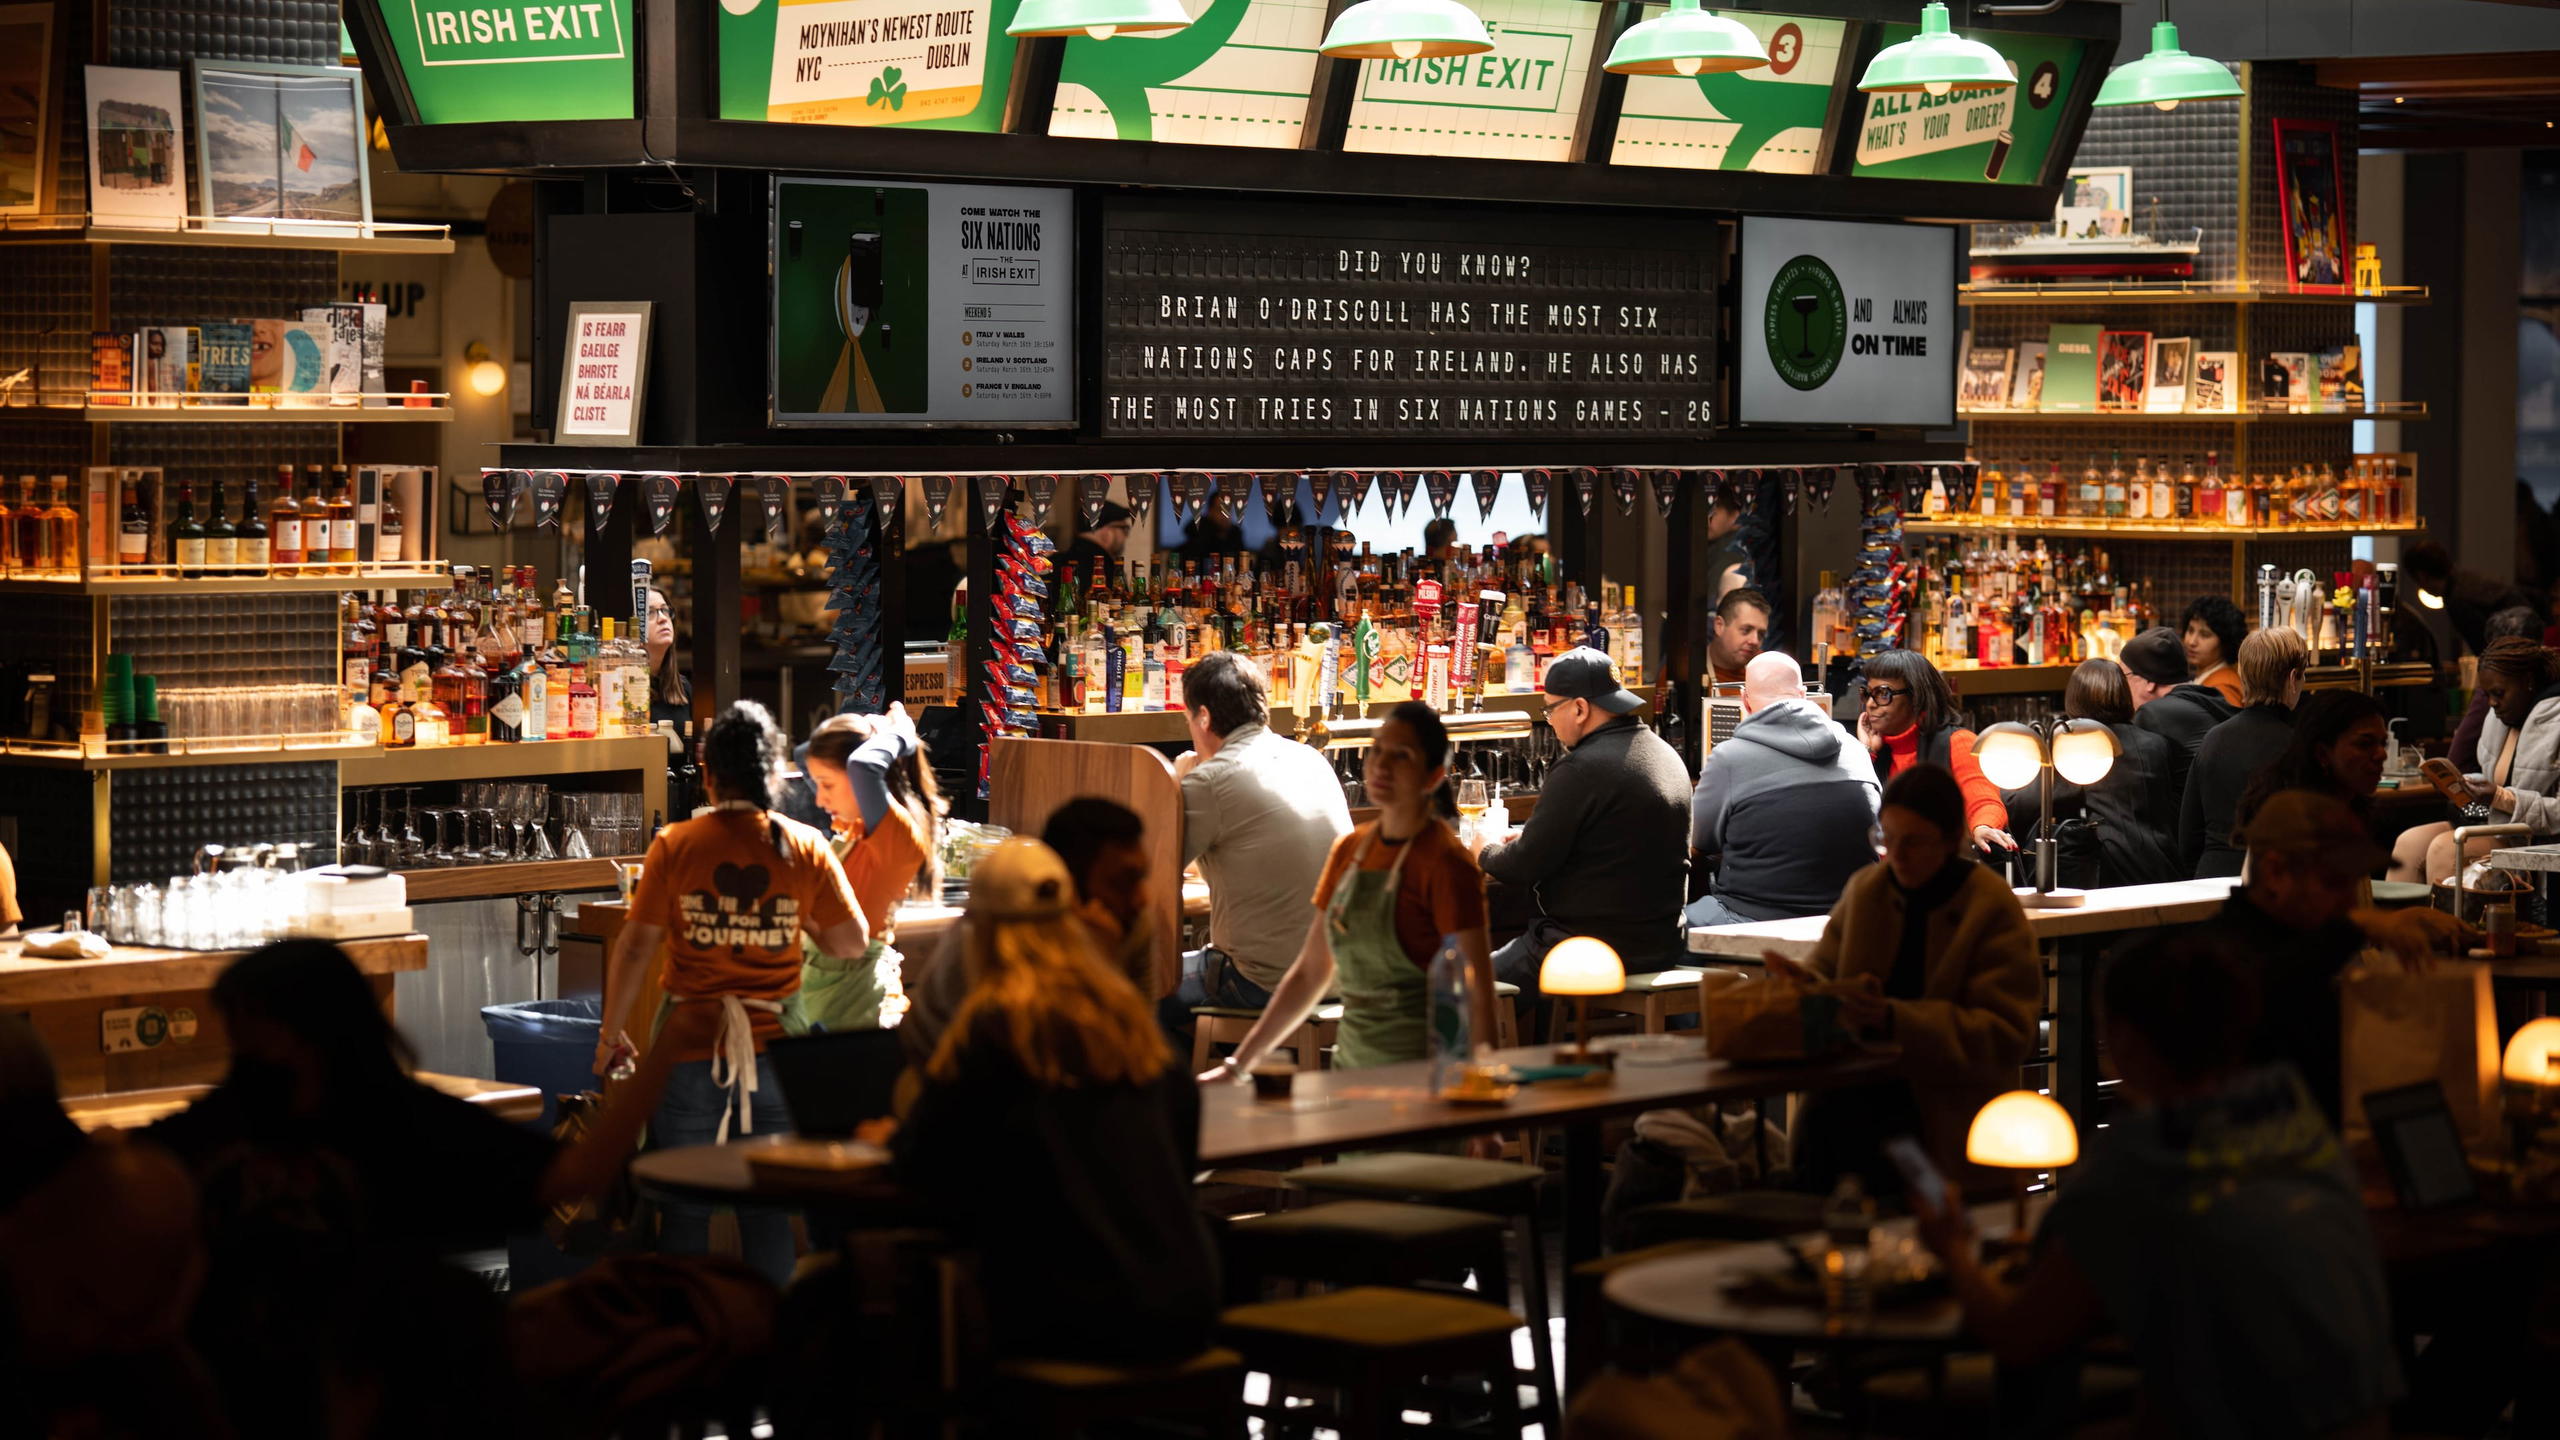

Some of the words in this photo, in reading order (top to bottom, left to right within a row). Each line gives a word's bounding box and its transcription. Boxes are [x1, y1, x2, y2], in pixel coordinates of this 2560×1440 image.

[426, 8, 517, 44] IRISH
[523, 4, 602, 40] EXIT
[800, 18, 879, 50] MOYNIHAN'S
[883, 13, 933, 42] NEWEST
[935, 10, 974, 36] ROUTE
[1776, 33, 1796, 62] 3
[796, 56, 822, 82] NYC
[926, 42, 970, 70] DUBLIN
[1379, 56, 1469, 86] IRISH
[1476, 56, 1554, 90] EXIT
[2033, 72, 2053, 99] 4
[1870, 96, 1912, 119] ALL
[1866, 121, 1907, 151] WHAT'S
[1923, 113, 1950, 140] YOUR
[1966, 102, 2006, 132] ORDER?
[961, 207, 985, 216] COME
[989, 208, 1020, 217] WATCH
[1023, 209, 1040, 218] THE
[961, 220, 983, 249] SIX
[987, 221, 1040, 251] NATIONS
[976, 267, 1006, 278] IRISH
[1009, 268, 1035, 279] EXIT
[1339, 250, 1380, 272] DID
[1400, 252, 1441, 274] YOU
[1461, 254, 1530, 278] KNOW?
[383, 283, 425, 317] UP
[1853, 298, 1872, 323] AND
[1893, 299, 1927, 325] ALWAYS
[964, 306, 987, 318] WEEKEND
[1161, 296, 1237, 318] BRIAN
[1260, 298, 1409, 323] O'DRISCOLL
[1431, 302, 1470, 324] HAS
[1491, 304, 1529, 325] THE
[1549, 305, 1601, 327] MOST
[1620, 307, 1657, 328] SIX
[583, 322, 592, 336] IS
[595, 322, 626, 337] FEARR
[201, 346, 251, 366] TREES
[581, 343, 620, 358] GAEILGE
[1852, 334, 1879, 355] ON
[1883, 334, 1926, 356] TIME
[2058, 344, 2092, 354] DIESEL
[579, 364, 618, 378] BHRISTE
[1144, 346, 1253, 369] NATIONS
[1275, 348, 1332, 371] CAPS
[1354, 349, 1394, 371] FOR
[1416, 350, 1526, 373] IRELAND.
[1548, 352, 1572, 373] HE
[1591, 353, 1642, 375] ALSO
[1661, 354, 1698, 375] HAS
[576, 383, 589, 400] NÁ
[594, 383, 630, 400] BÉARLA
[574, 406, 606, 421] CLISTE
[1110, 397, 1154, 420] THE
[1177, 397, 1237, 420] MOST
[1259, 398, 1332, 420] TRIES
[1353, 398, 1378, 420] IN
[1400, 398, 1439, 421] SIX
[1459, 399, 1557, 421] NATIONS
[1576, 400, 1642, 421] GAMES
[1688, 400, 1710, 421] 26
[1454, 623, 1465, 676] WOLFHOUND
[1465, 623, 1476, 676] WOLFHOUND
[905, 672, 944, 691] ESPRESSO
[905, 695, 944, 704] MARTINI
[728, 914, 761, 927] FOR
[683, 924, 798, 946] JOURNEY
